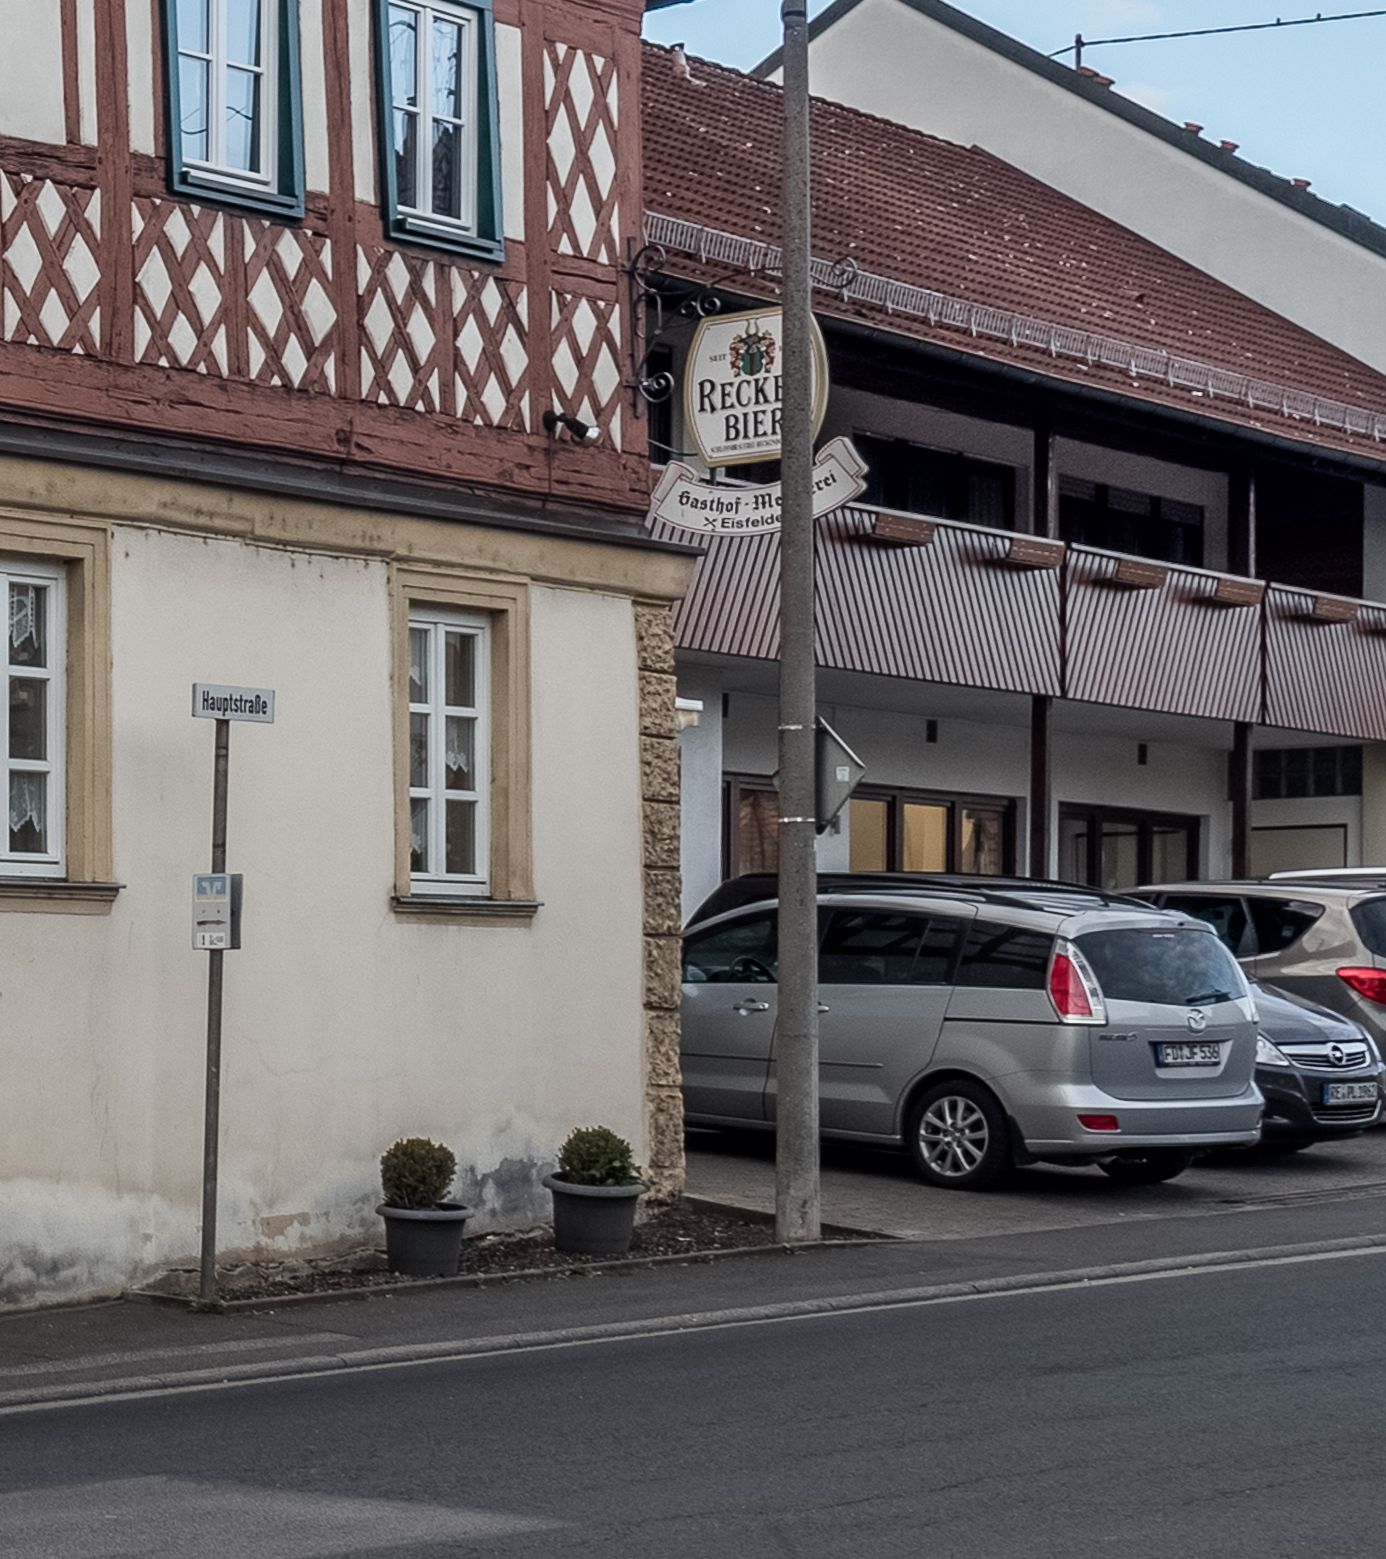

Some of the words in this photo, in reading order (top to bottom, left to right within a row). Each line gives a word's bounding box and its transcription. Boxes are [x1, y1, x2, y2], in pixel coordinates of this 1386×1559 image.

[698, 375, 782, 414] RECKE
[679, 490, 742, 515] Gasthof
[201, 690, 268, 717] Hauptstraße
